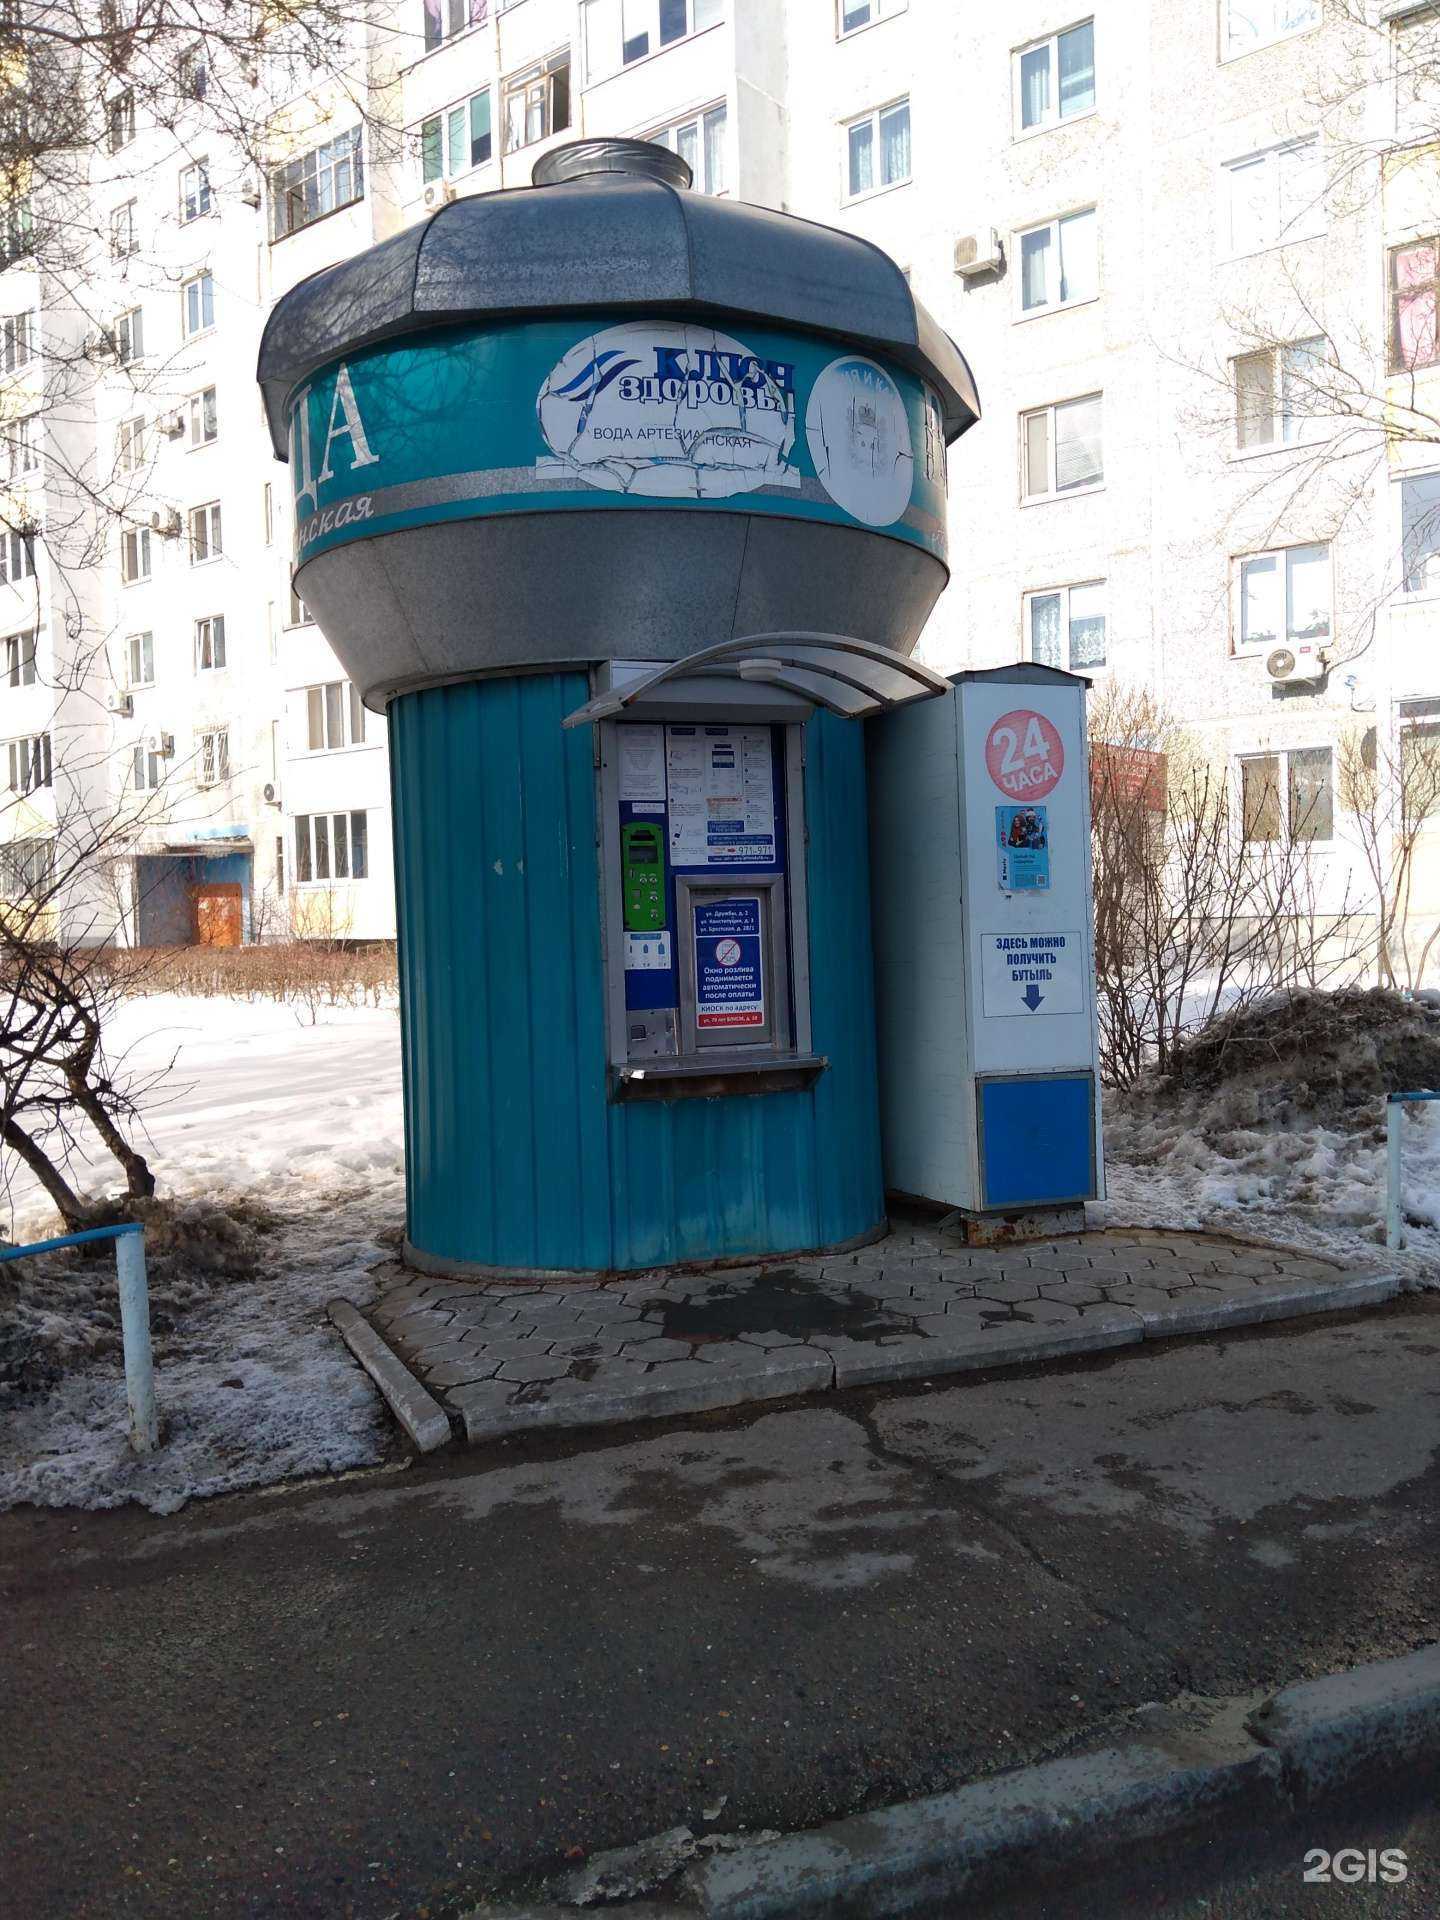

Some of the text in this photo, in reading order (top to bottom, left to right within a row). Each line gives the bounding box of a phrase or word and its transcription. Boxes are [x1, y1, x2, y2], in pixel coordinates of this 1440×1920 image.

[593, 428, 752, 448] ВОДА АРТЕЗИАНСКАЯ
[992, 716, 1050, 776] 24
[1002, 762, 1058, 792] ЧАСА
[996, 936, 1065, 950] ЗДЕСЬ МОЖНО
[1006, 952, 1057, 965] ПОЛУЧИТЬ
[724, 966, 754, 975] розлива
[1012, 968, 1052, 981] БУТЫЛЬ
[705, 975, 753, 983] поднимается
[702, 983, 757, 991] автоматически
